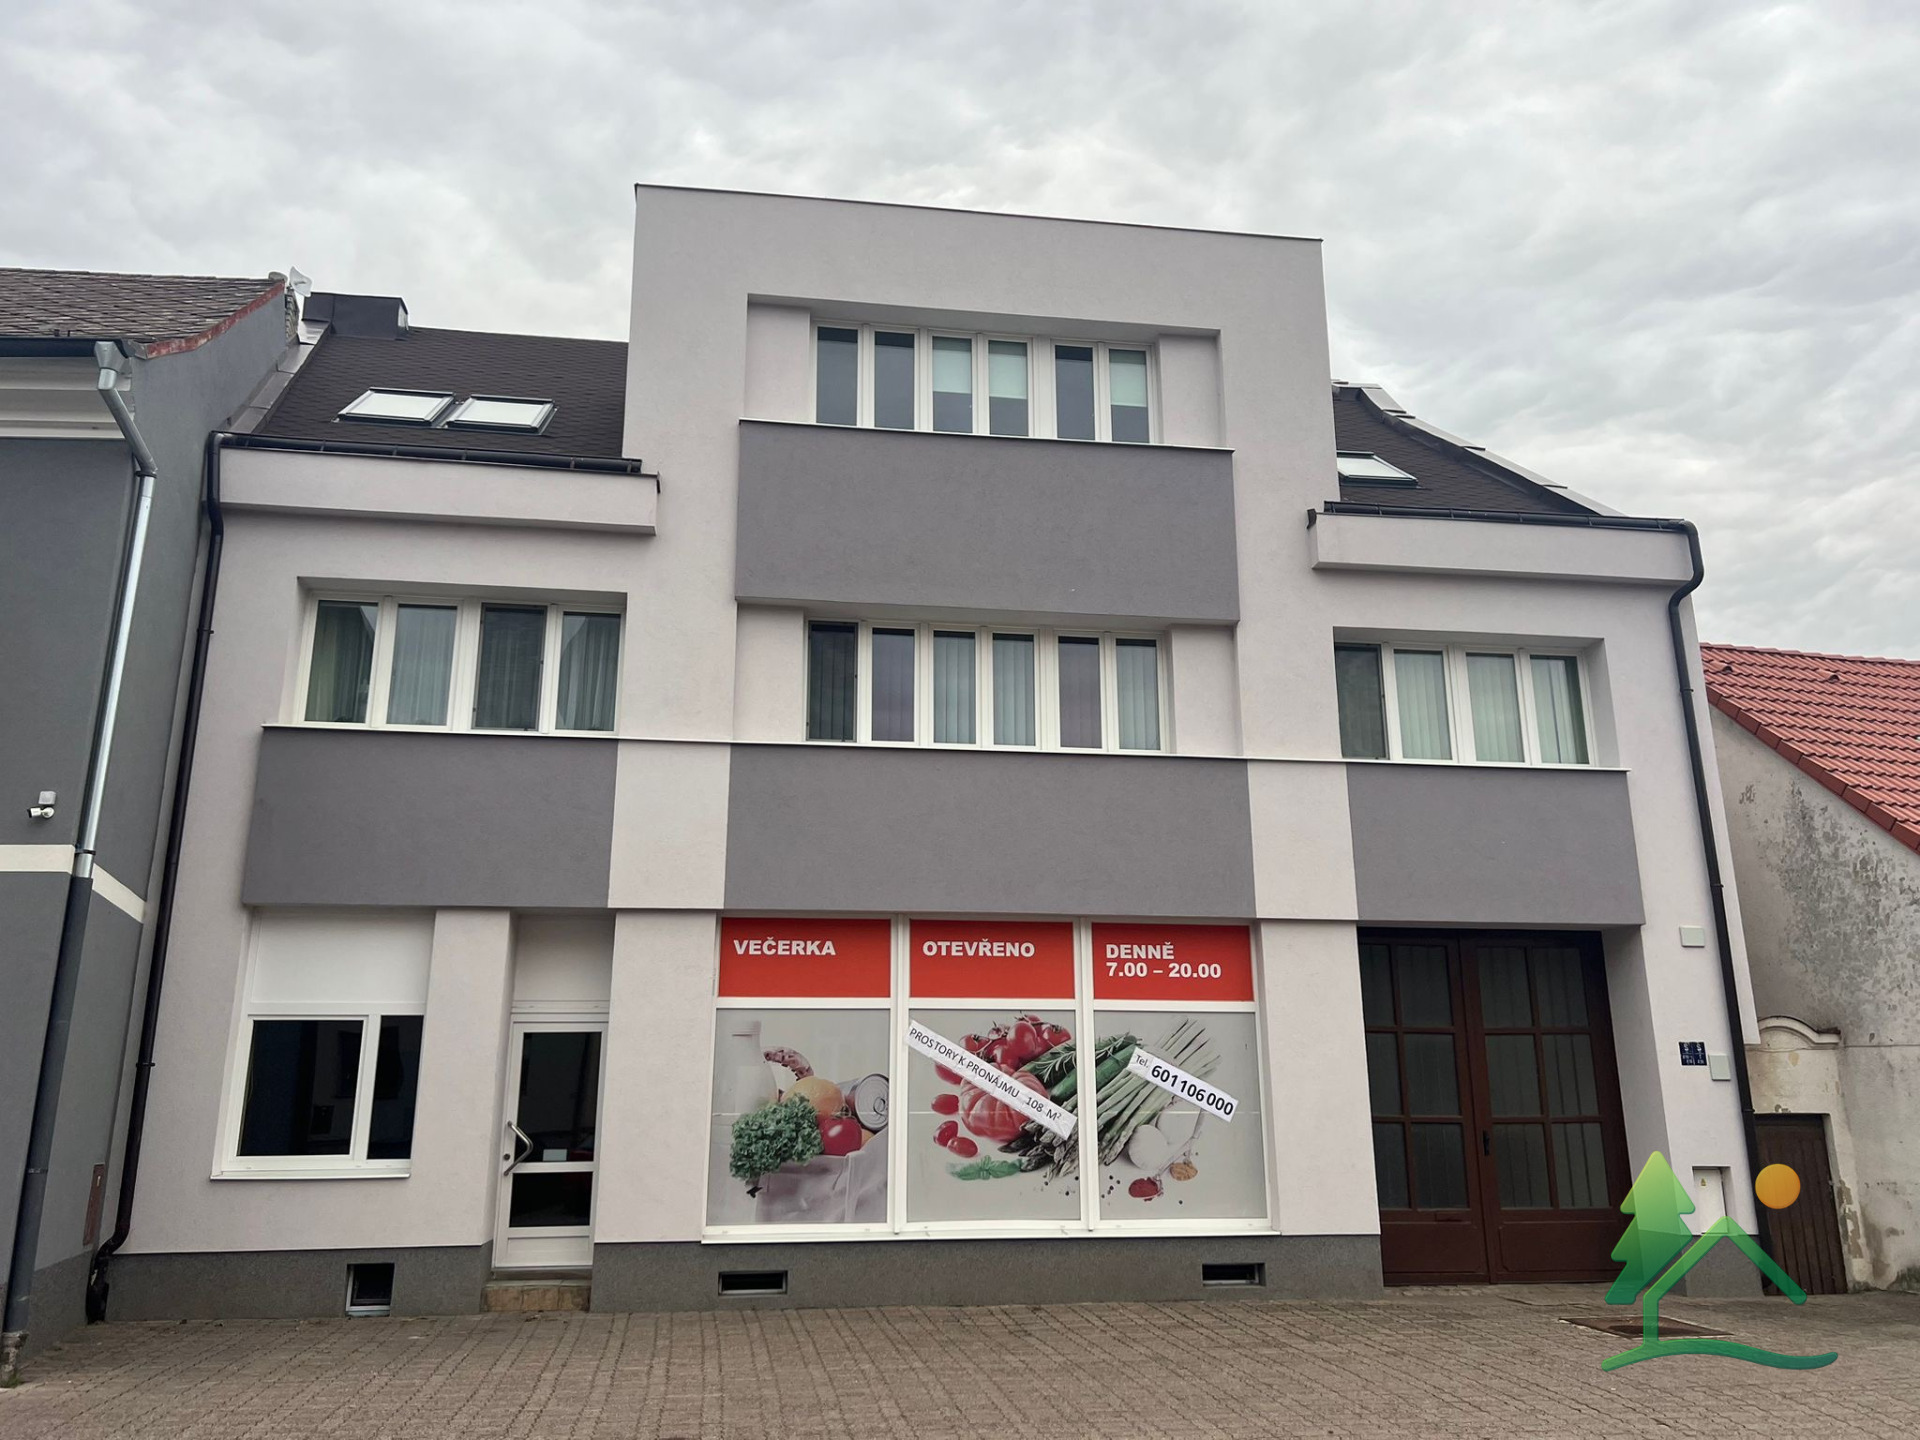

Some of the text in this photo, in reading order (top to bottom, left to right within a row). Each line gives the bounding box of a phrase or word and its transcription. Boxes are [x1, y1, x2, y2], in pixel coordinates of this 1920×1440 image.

[733, 936, 836, 956] VEČERKA
[922, 938, 1035, 957] OTEVŘENO
[1106, 941, 1175, 960] DENNĚ
[1106, 962, 1147, 977] 7.00
[1168, 963, 1222, 978] 20.00
[909, 1028, 958, 1060] PROSTORY
[958, 1055, 967, 1066] K
[966, 1060, 1020, 1098] PRONÁJMU
[1026, 1097, 1044, 1113] 108
[1135, 1054, 1149, 1069] Tel.
